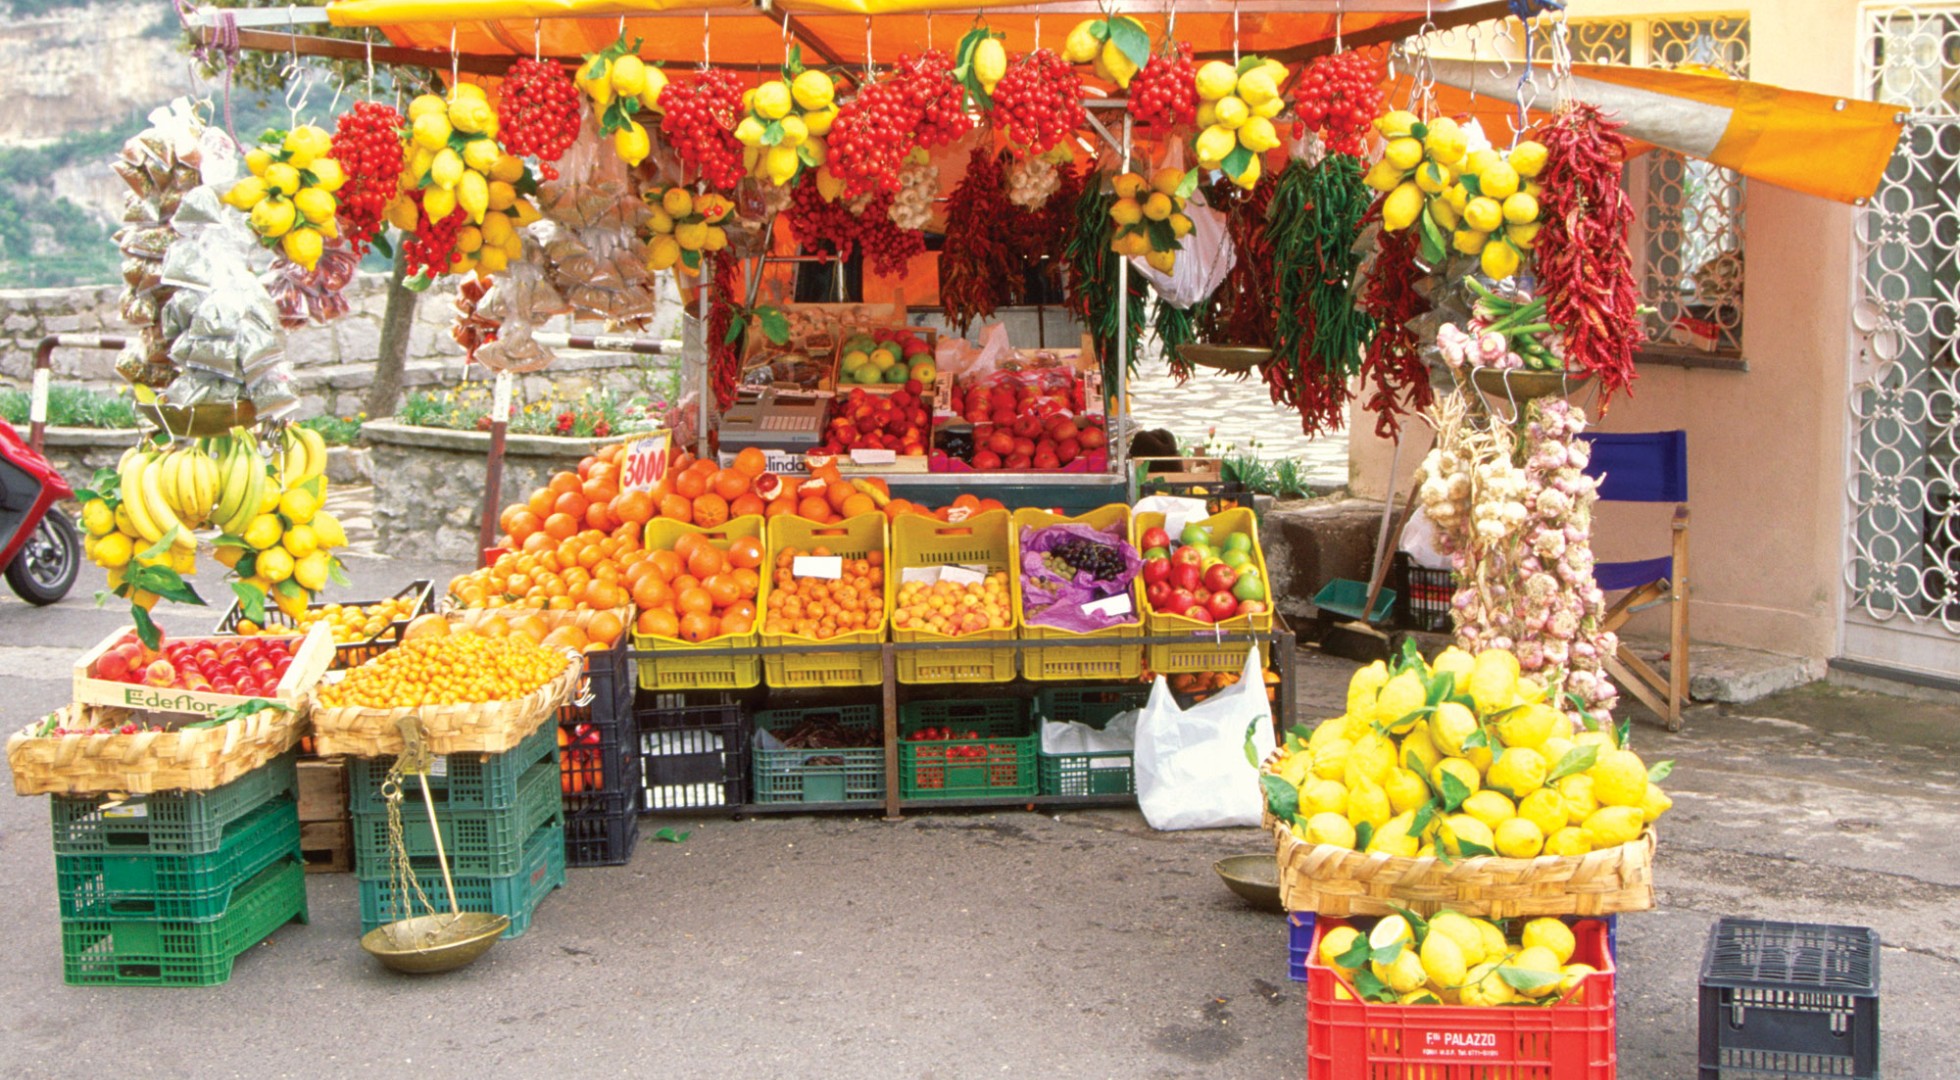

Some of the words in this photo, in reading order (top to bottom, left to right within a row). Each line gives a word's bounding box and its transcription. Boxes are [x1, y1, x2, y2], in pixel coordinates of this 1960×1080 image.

[623, 449, 666, 487] 3000
[764, 456, 805, 472] linda
[125, 688, 218, 712] Edeflor
[1444, 1032, 1496, 1046] PALAZZO
